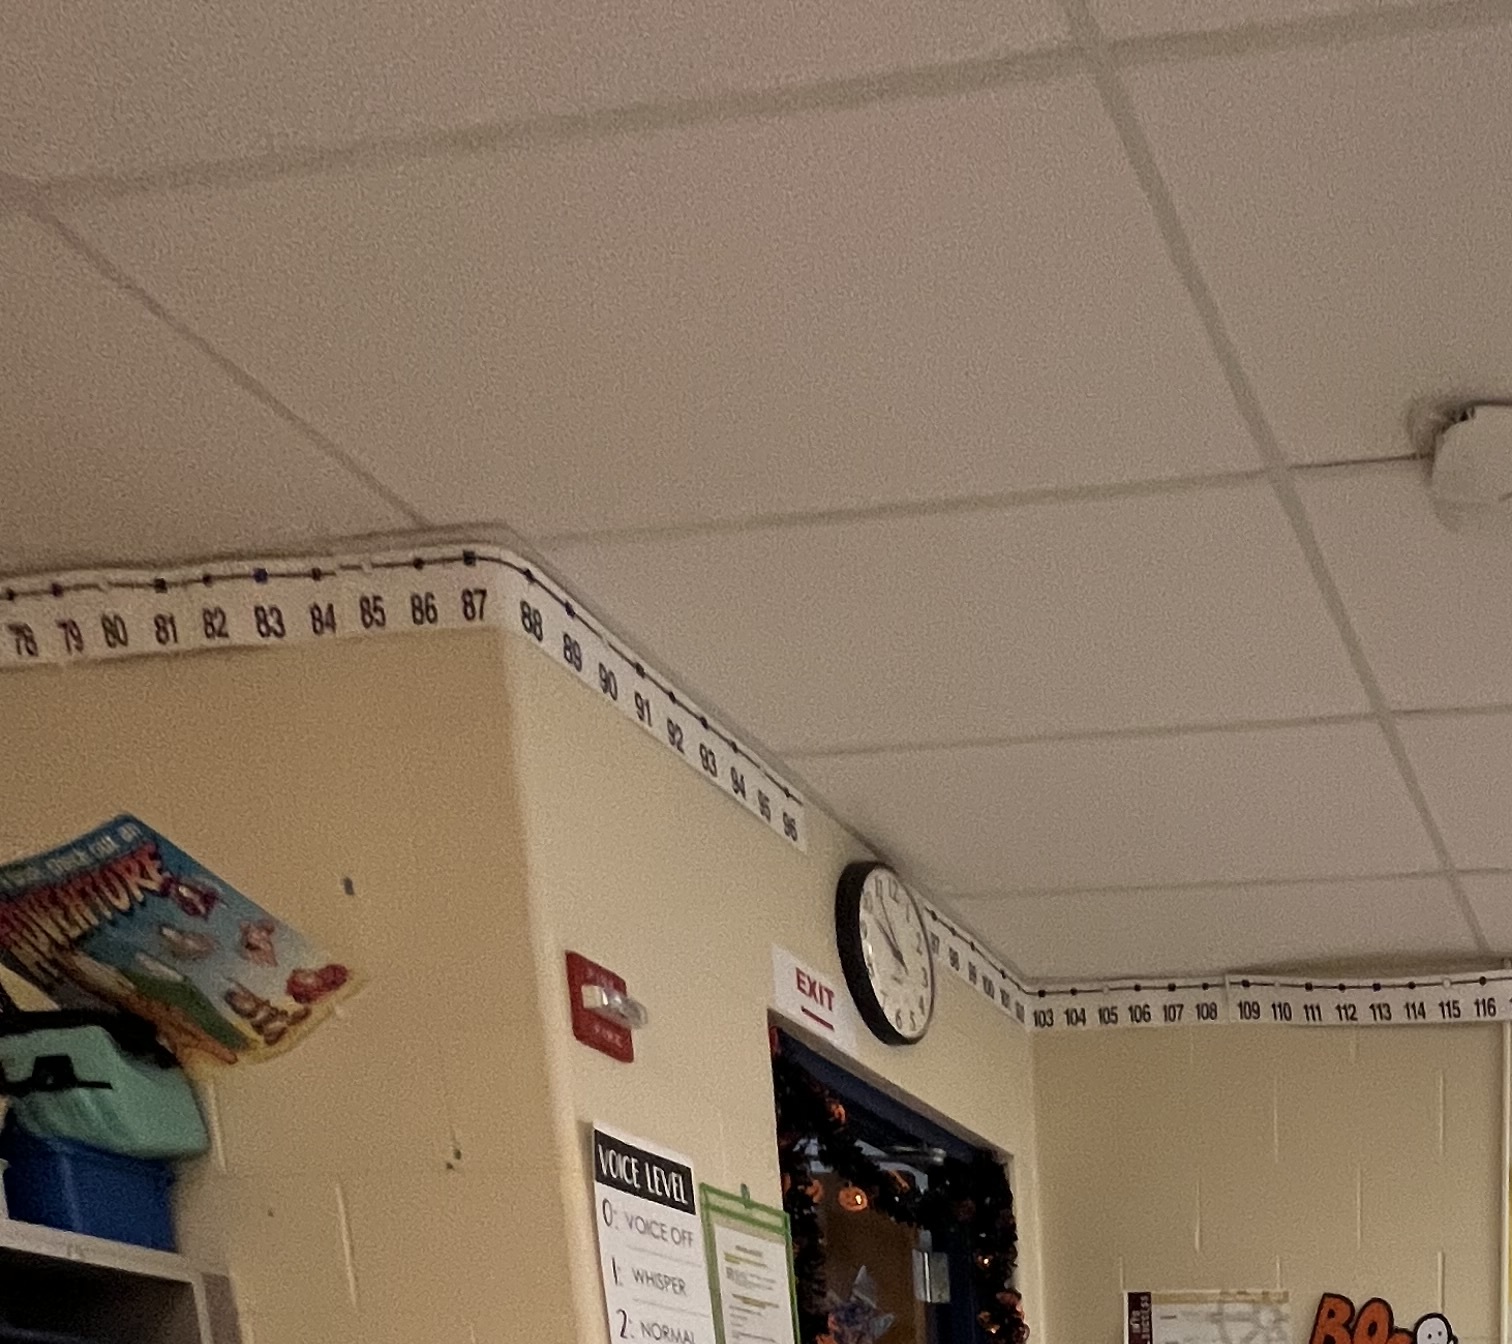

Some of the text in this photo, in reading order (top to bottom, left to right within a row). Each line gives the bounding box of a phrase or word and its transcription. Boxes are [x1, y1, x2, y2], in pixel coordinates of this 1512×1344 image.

[203, 590, 487, 639] 82 83 86 87
[521, 601, 582, 671] 88 89
[796, 967, 834, 1011] EXIT
[1238, 1002, 1261, 1019] 109
[1304, 1003, 1322, 1021] 111
[599, 1145, 688, 1205] VOICE LEVEL
[602, 1198, 693, 1247] 0: VOICE OFF
[612, 1258, 686, 1296] 1: WHISPER
[616, 1309, 634, 1339] 2:
